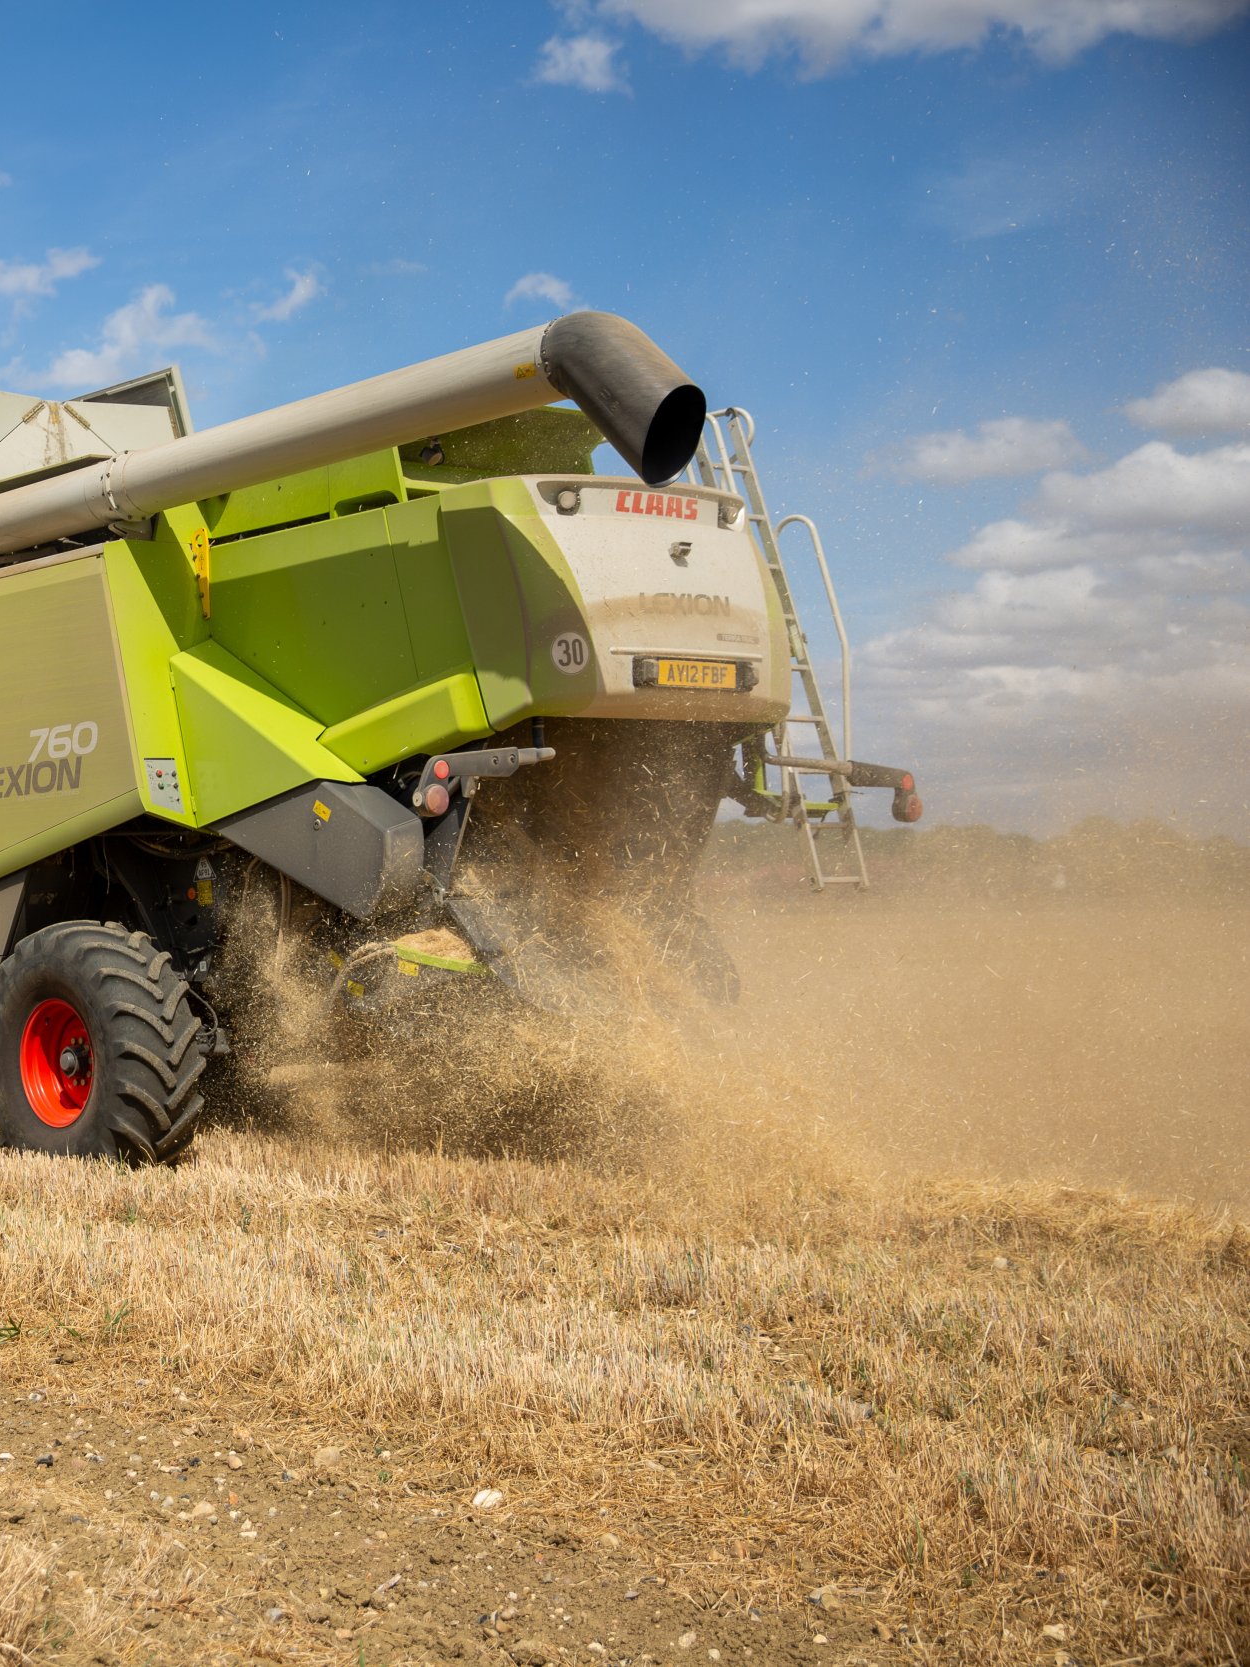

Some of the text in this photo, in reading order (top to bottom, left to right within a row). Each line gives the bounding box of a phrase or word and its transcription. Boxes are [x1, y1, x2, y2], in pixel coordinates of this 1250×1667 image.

[616, 490, 698, 520] CLAAS
[638, 592, 730, 617] LEXION
[557, 638, 584, 667] 30
[667, 663, 729, 685] AY12 FBF
[28, 720, 98, 763] 760
